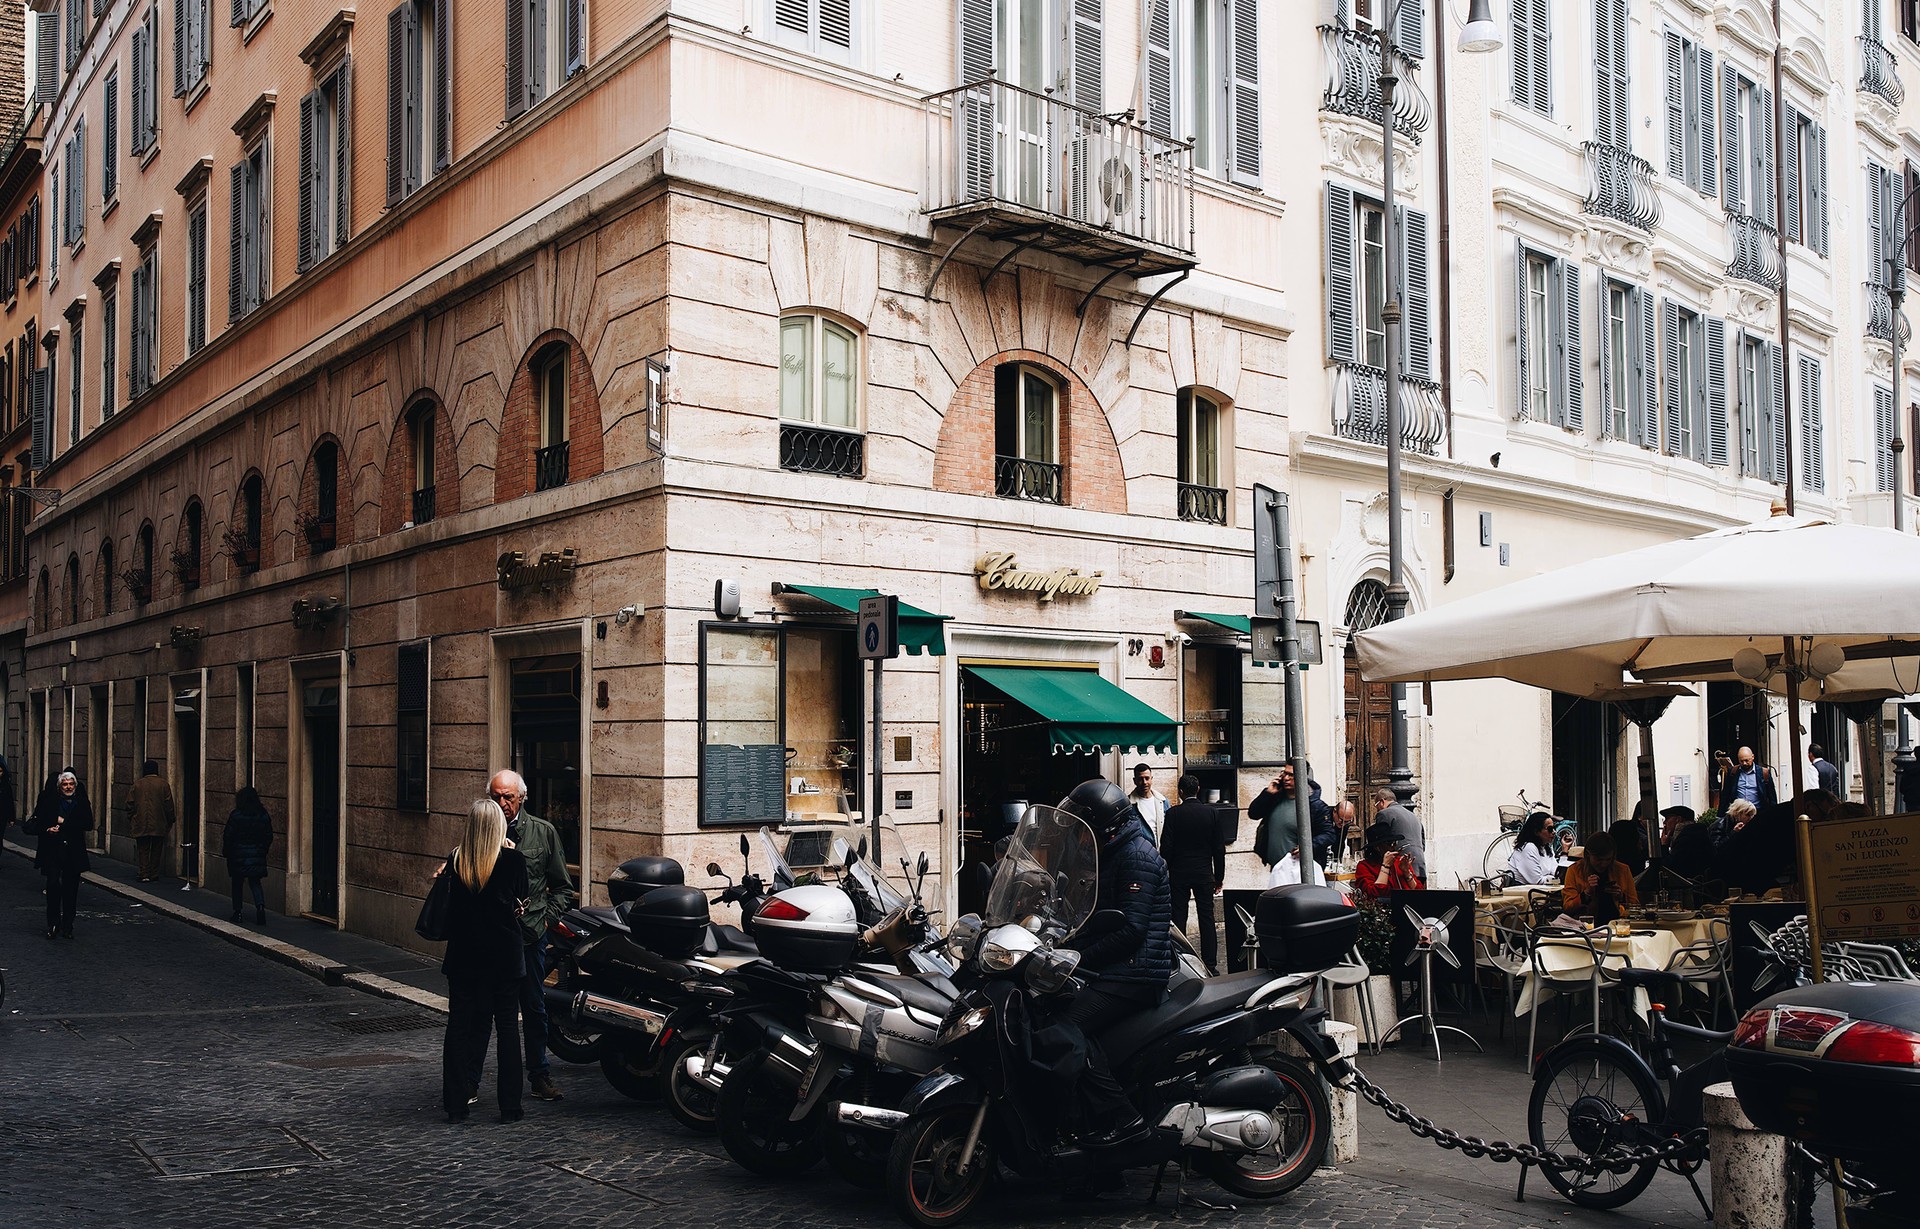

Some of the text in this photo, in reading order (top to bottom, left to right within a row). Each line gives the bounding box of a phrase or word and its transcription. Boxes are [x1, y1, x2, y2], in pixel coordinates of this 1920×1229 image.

[974, 551, 1105, 601] Ciampini
[863, 610, 881, 619] pedonale
[1128, 638, 1143, 656] 29
[1851, 828, 1889, 839] PIAZZA
[1834, 836, 1909, 852] SAN LORENZO
[1845, 849, 1900, 861] IN LUCINA
